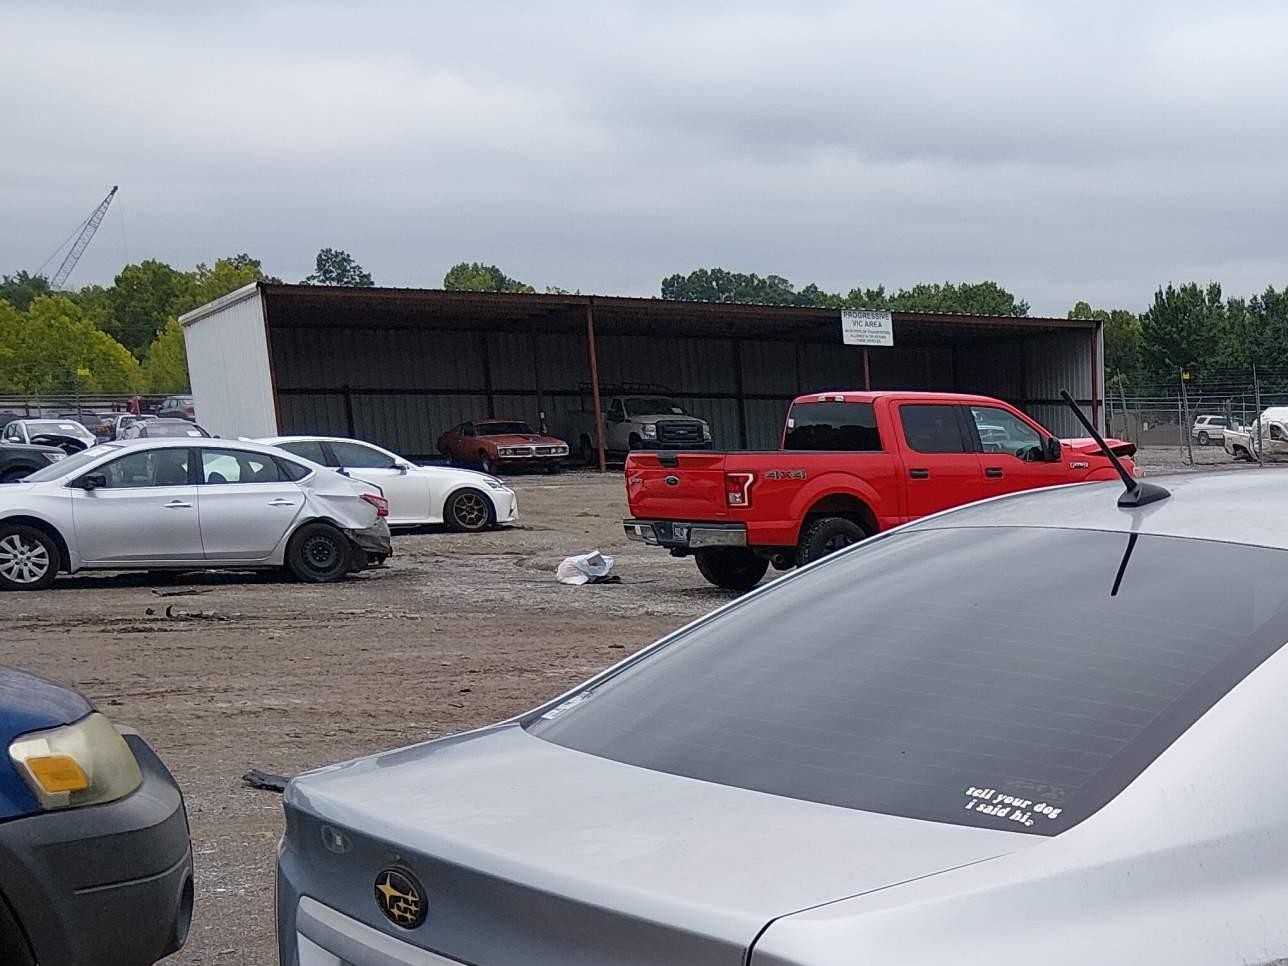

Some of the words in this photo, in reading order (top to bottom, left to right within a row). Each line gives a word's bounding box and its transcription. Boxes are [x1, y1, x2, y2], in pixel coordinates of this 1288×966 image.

[966, 787, 996, 800] tell
[992, 794, 1032, 808] your
[1033, 802, 1062, 819] dog
[976, 803, 1011, 817] said
